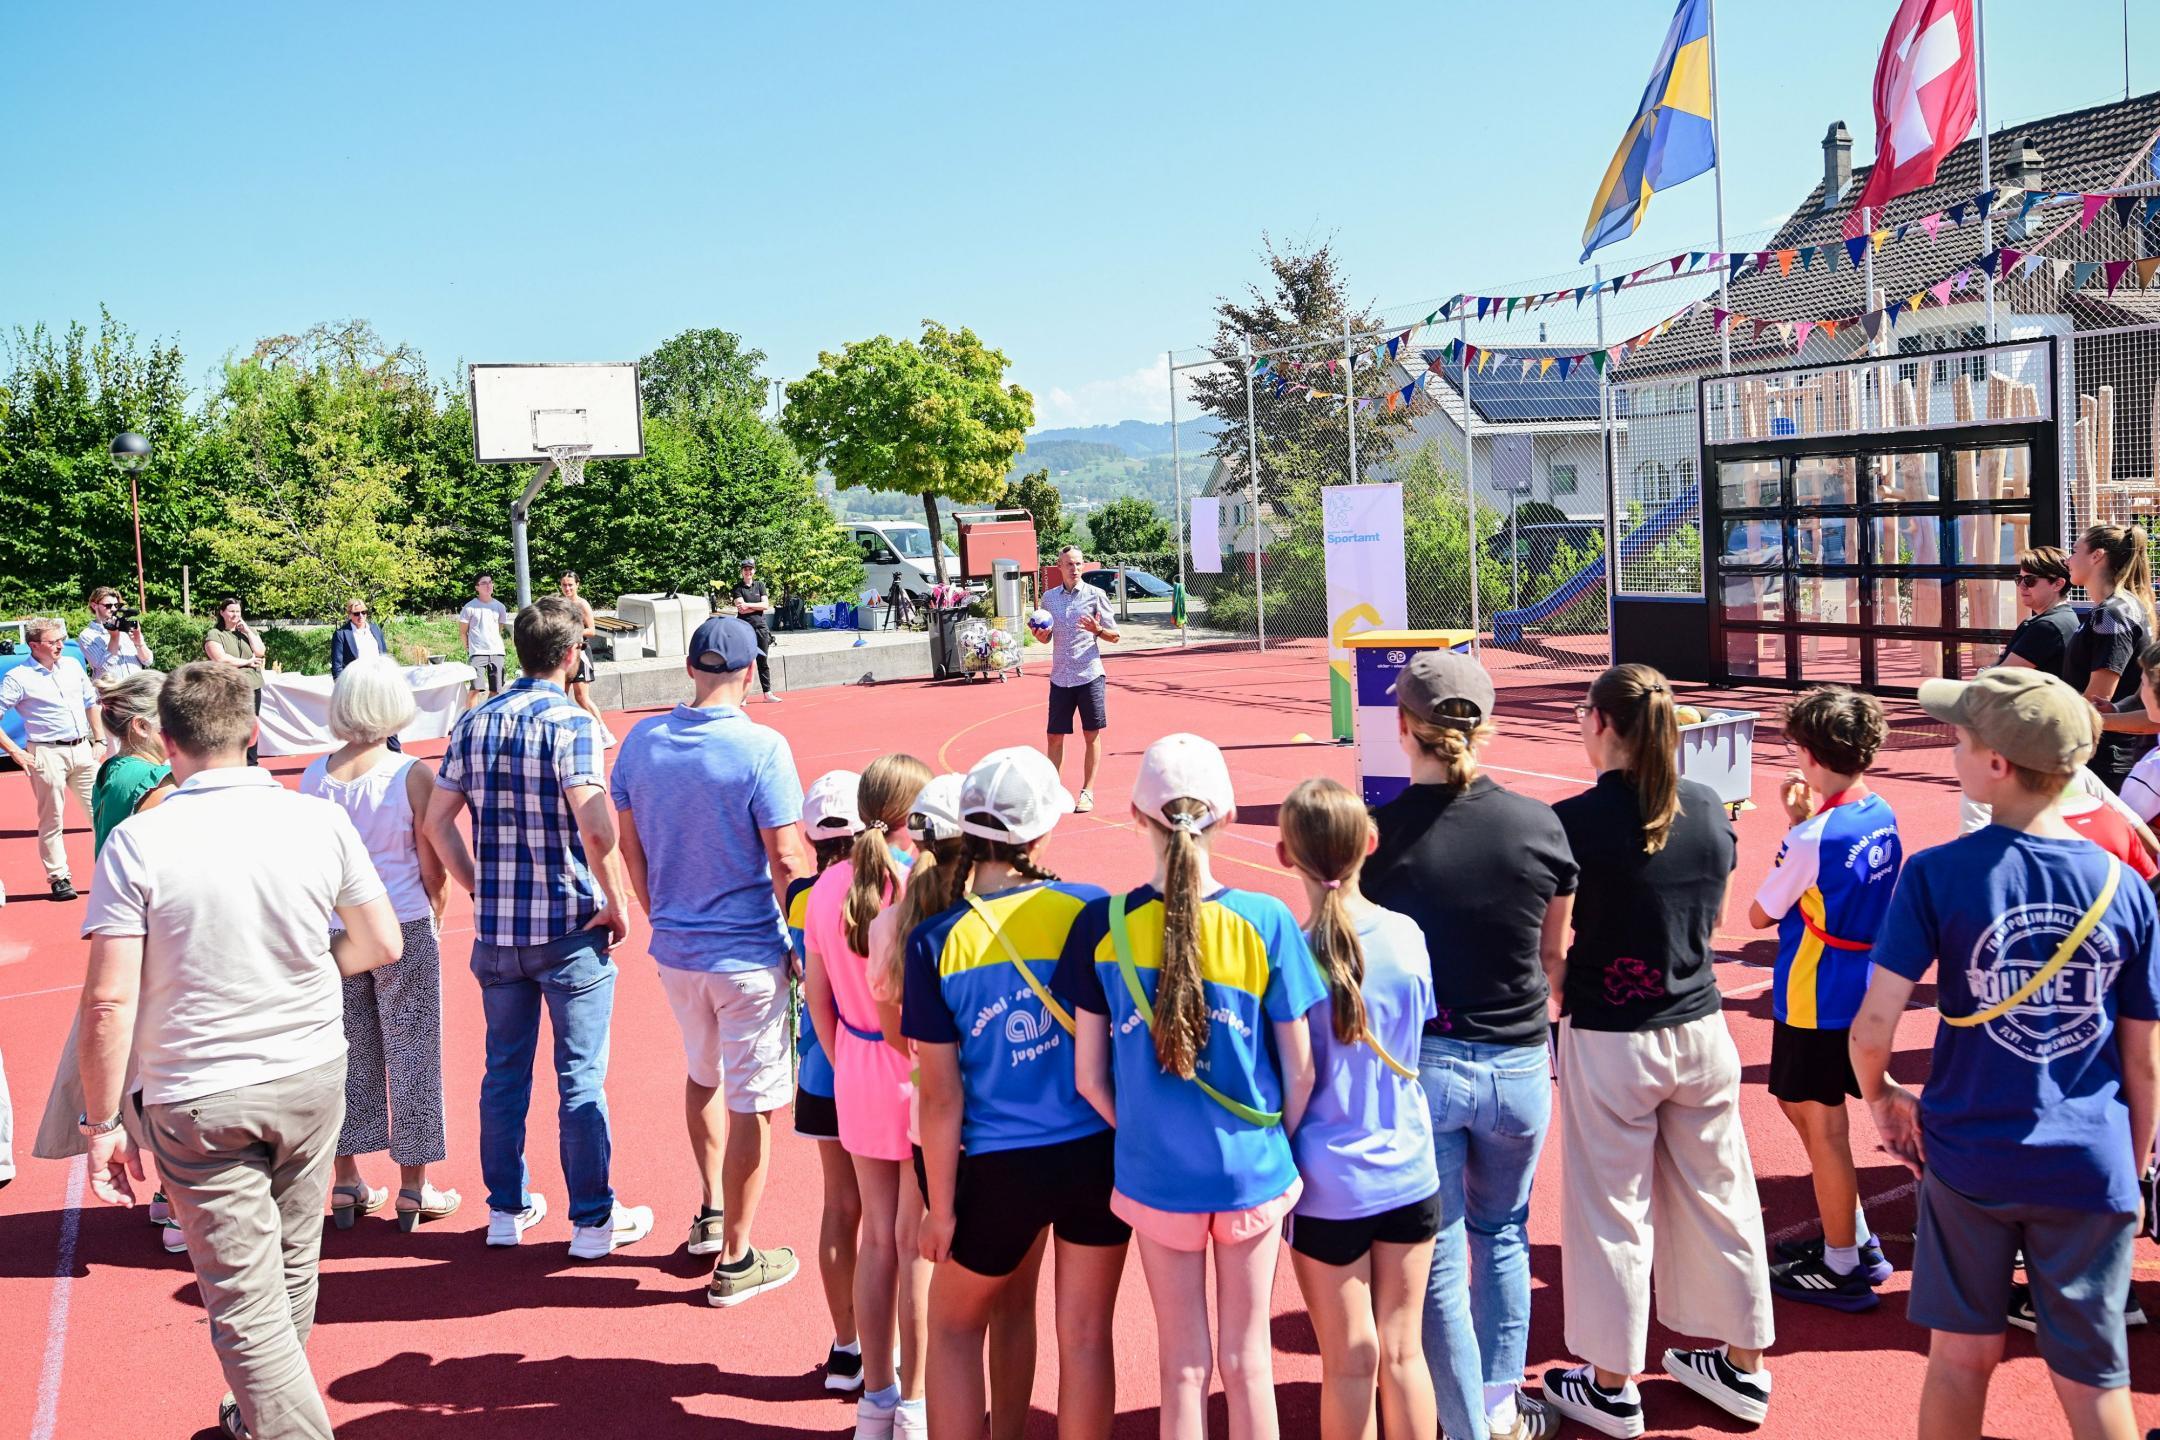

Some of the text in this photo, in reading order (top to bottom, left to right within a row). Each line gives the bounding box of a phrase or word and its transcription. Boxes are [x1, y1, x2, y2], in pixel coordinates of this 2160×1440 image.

[1327, 533, 1380, 544] Sportamt
[1985, 911, 2077, 953] TRAMPOLINHALL
[971, 996, 1008, 1037] aathal
[1011, 1033, 1060, 1068] jugend
